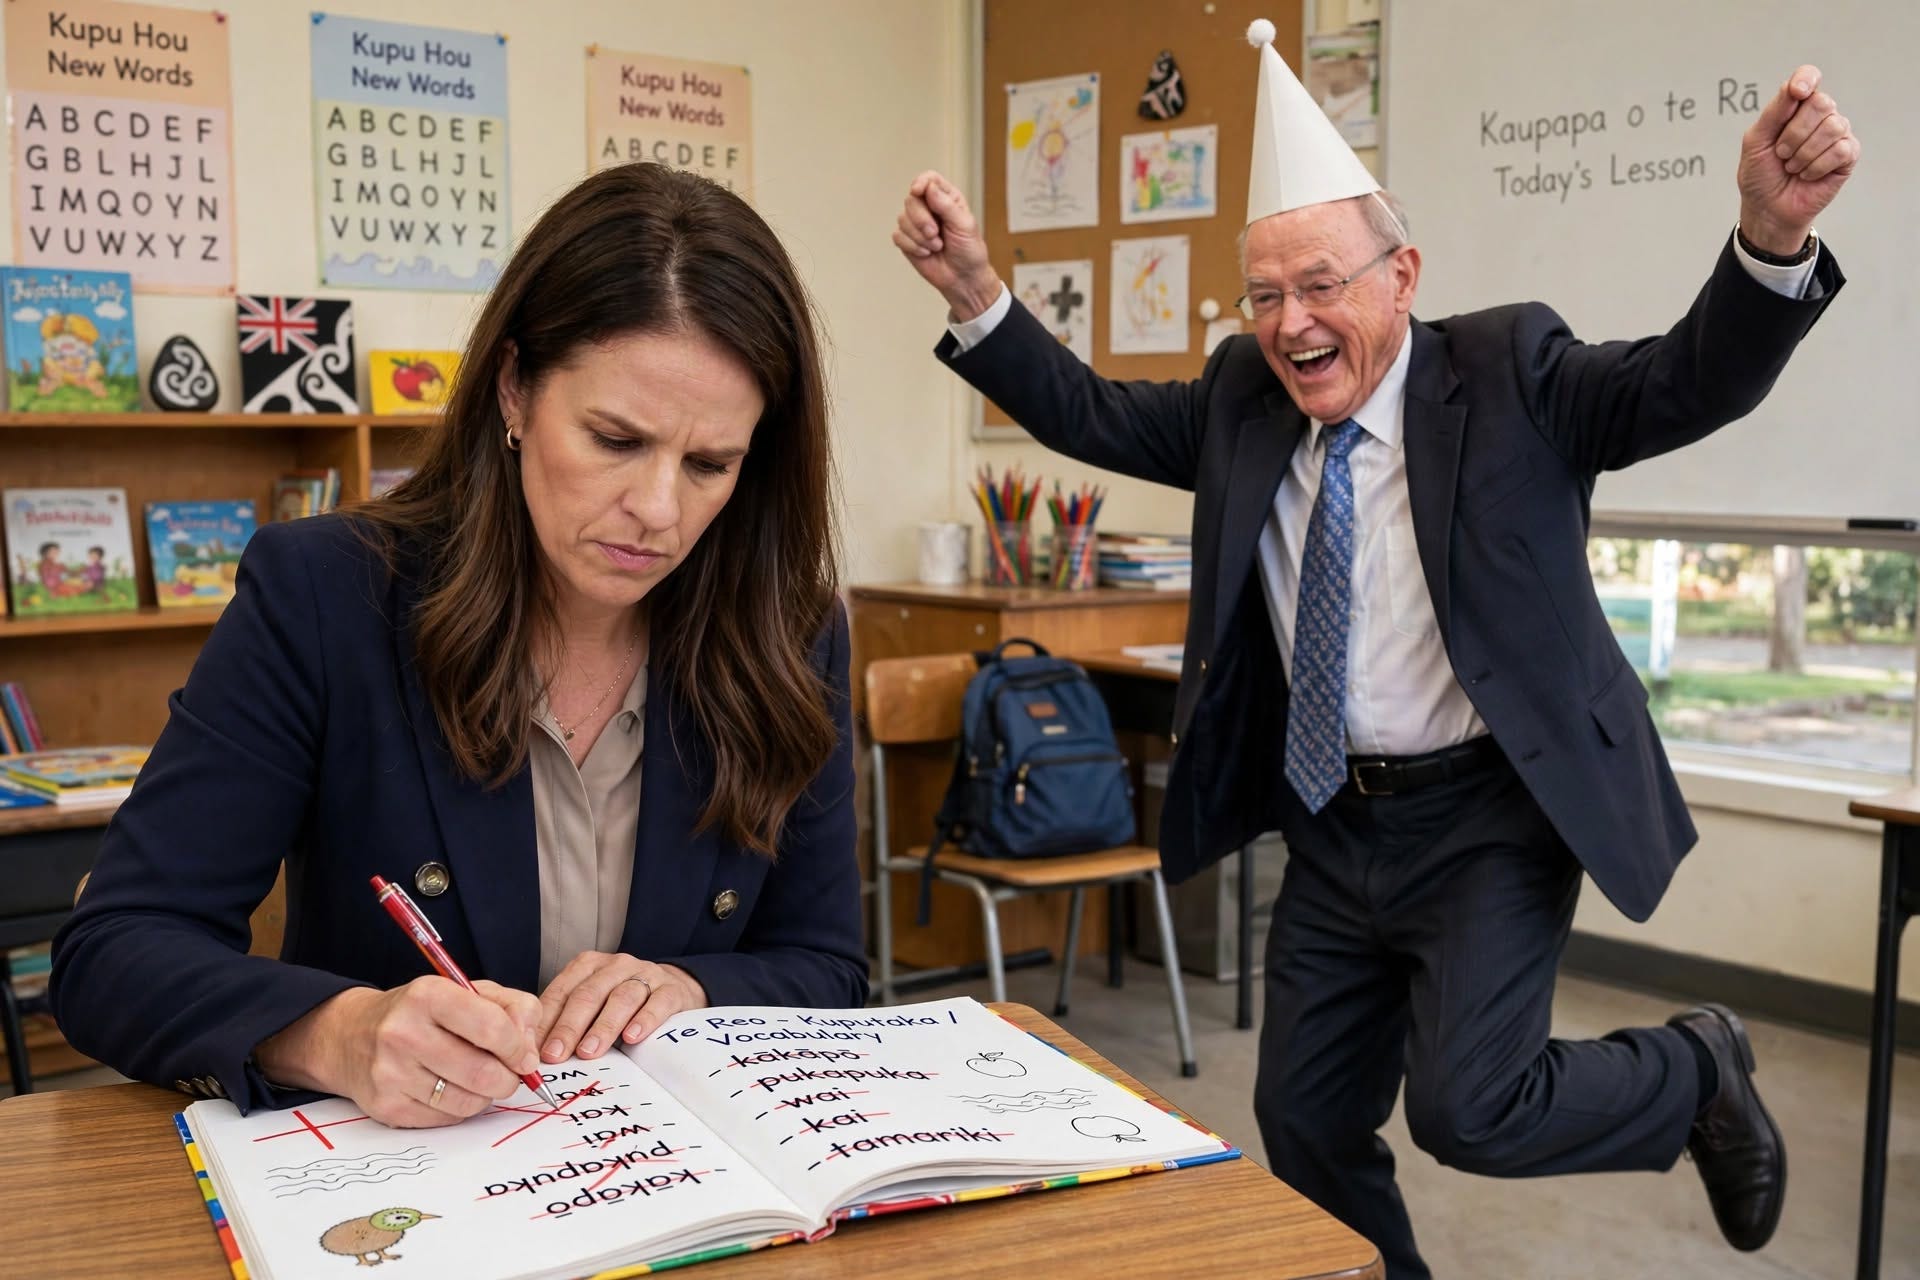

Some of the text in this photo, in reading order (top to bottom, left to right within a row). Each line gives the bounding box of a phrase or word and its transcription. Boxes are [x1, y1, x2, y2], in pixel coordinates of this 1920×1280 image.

[48, 11, 188, 52] Kupu Hou
[352, 32, 471, 68] Kupu Hou
[48, 50, 194, 87] New Words
[352, 66, 476, 100] New Words
[621, 65, 722, 98] Kupu Hou
[25, 103, 212, 144] A B C D E F
[327, 106, 492, 144] A B C D E F
[619, 96, 725, 127] New Words
[1480, 77, 1759, 152] Kaupapa o te Rā
[25, 144, 215, 183] G B L H J L
[327, 142, 494, 179] G B L H J L
[602, 136, 739, 169] A B C D E F
[332, 178, 496, 213] I M Q O Y N
[1494, 154, 1705, 204] Today's Lesson
[30, 184, 218, 221] I M Q O Y N
[29, 225, 219, 262] V U W X Y Z
[330, 215, 496, 249] V U W X Y Z
[657, 1027, 699, 1044] Te
[706, 1016, 766, 1030] Reo
[706, 1029, 882, 1046] Vocabulary
[731, 1049, 861, 1068] kākāpō
[757, 1067, 930, 1092] pukapuka
[781, 1087, 851, 1109] wai
[570, 1105, 629, 1126] kai
[802, 1109, 869, 1133] kai
[582, 1124, 650, 1148] wai
[830, 1127, 1002, 1159] tamariki
[485, 1140, 673, 1196] pukapuka
[547, 1169, 701, 1218] kākāpō
